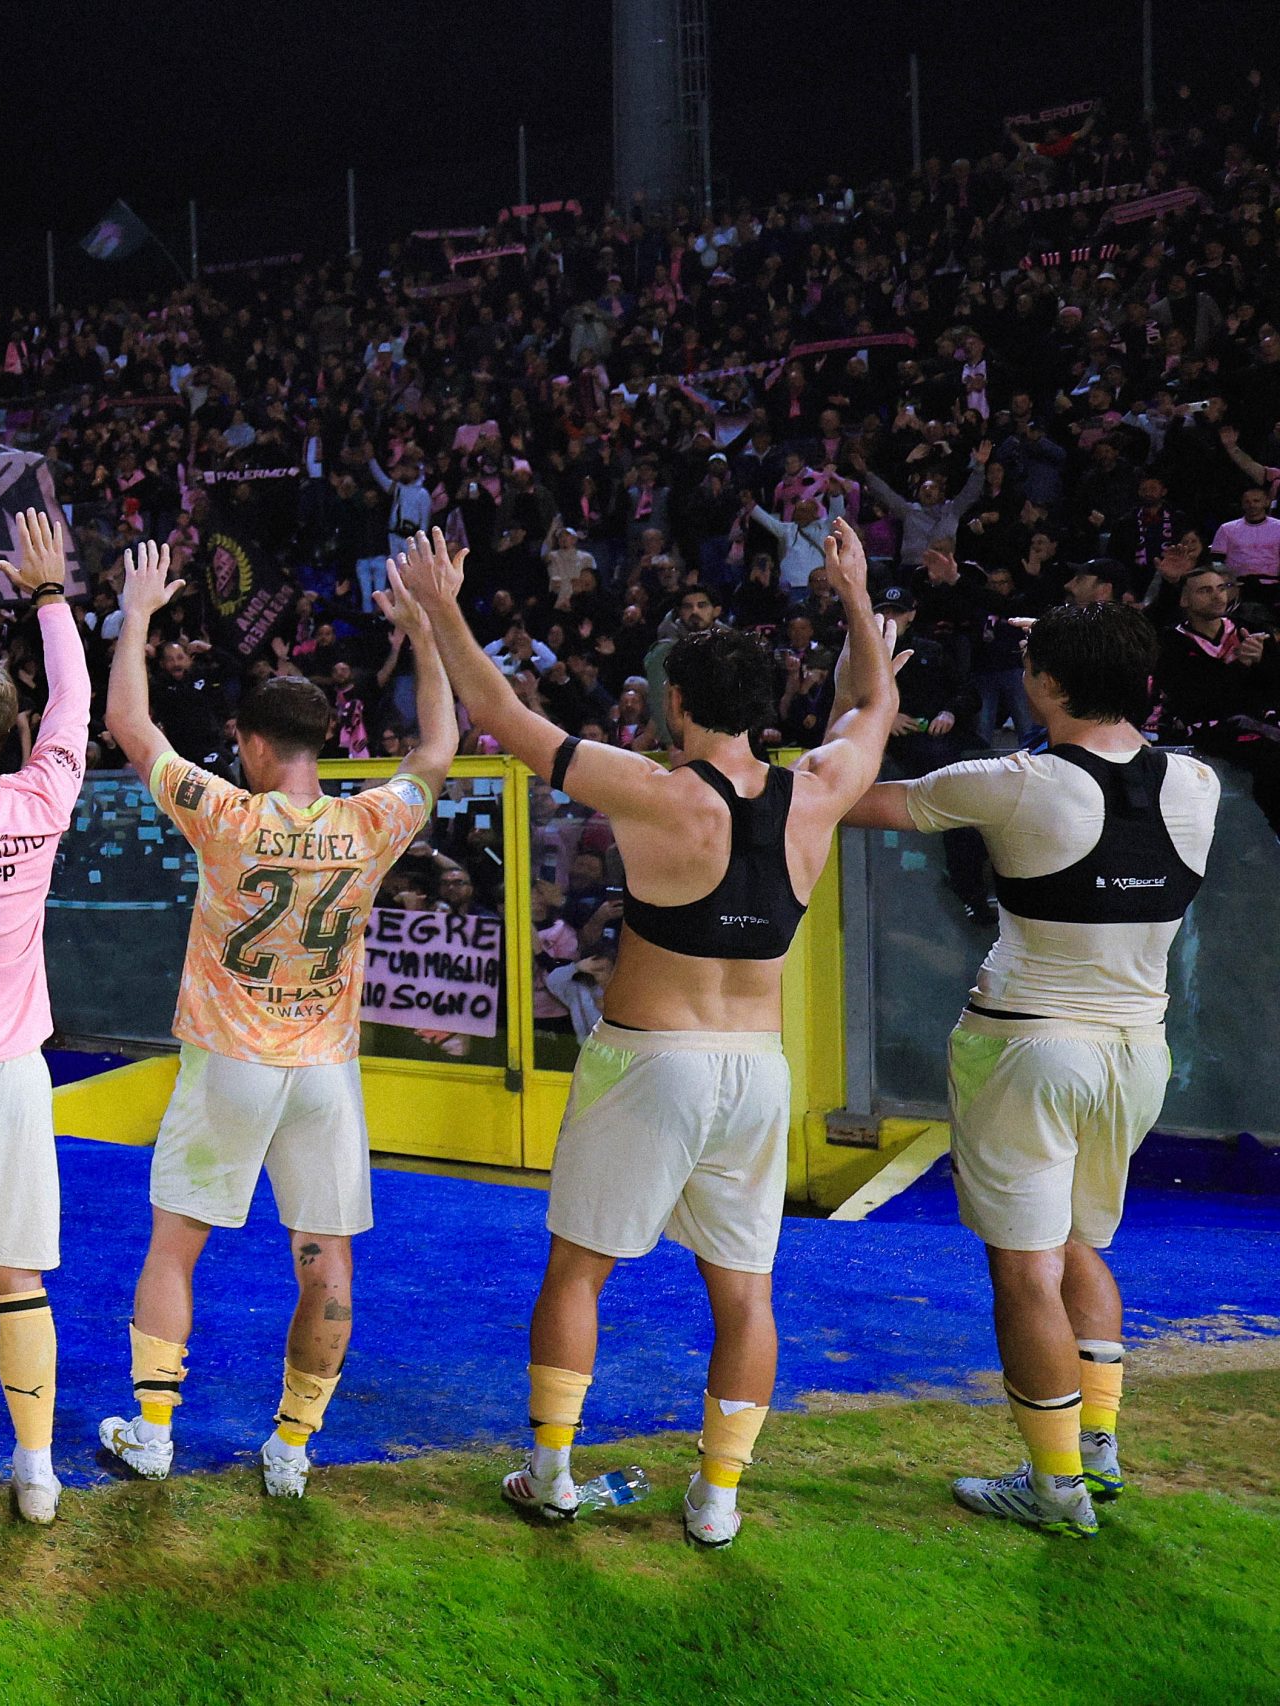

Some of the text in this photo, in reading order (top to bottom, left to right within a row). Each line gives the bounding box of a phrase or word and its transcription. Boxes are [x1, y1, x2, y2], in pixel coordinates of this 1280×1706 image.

[221, 864, 362, 985] 24
[365, 908, 501, 950] EGRE
[389, 983, 492, 1020] SOGNO
